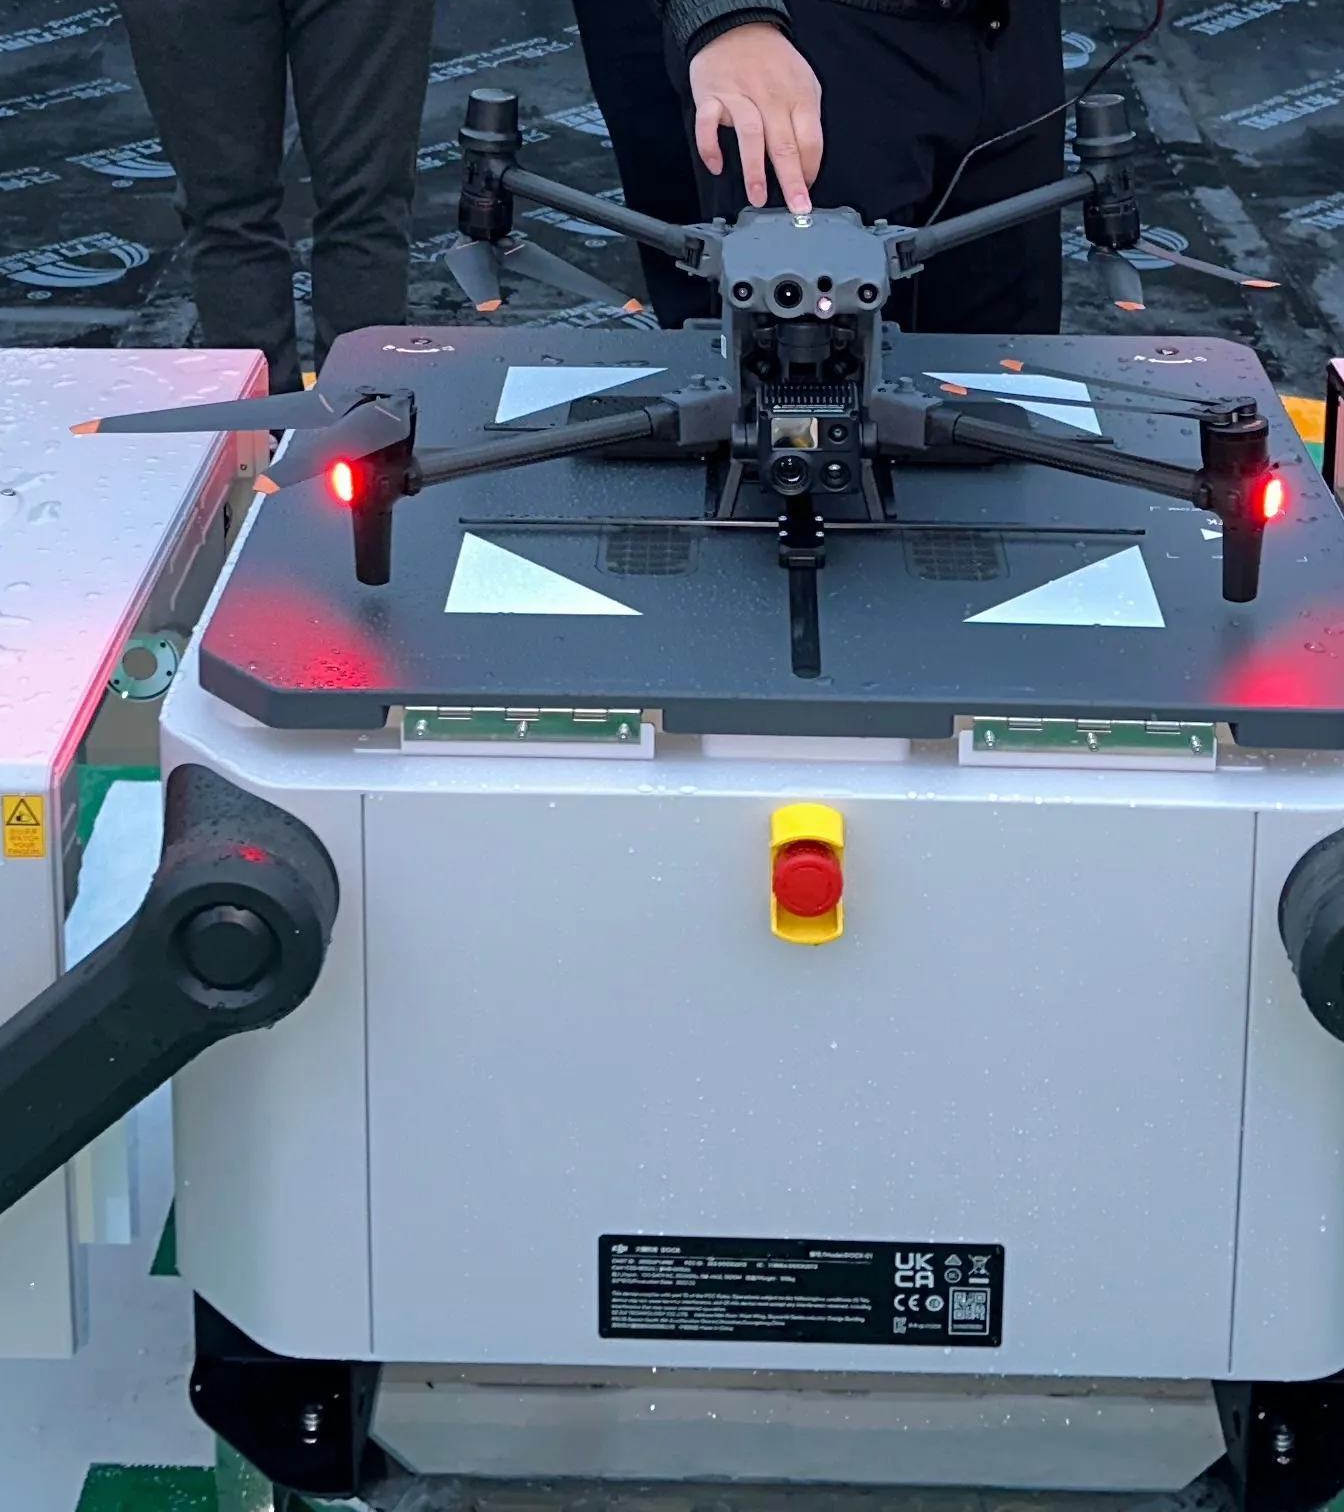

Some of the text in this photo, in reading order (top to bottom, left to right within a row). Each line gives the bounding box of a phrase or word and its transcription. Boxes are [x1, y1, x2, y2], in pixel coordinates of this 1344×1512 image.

[894, 1252, 935, 1271] UK
[894, 1270, 935, 1289] CA
[893, 1293, 921, 1312] CE
